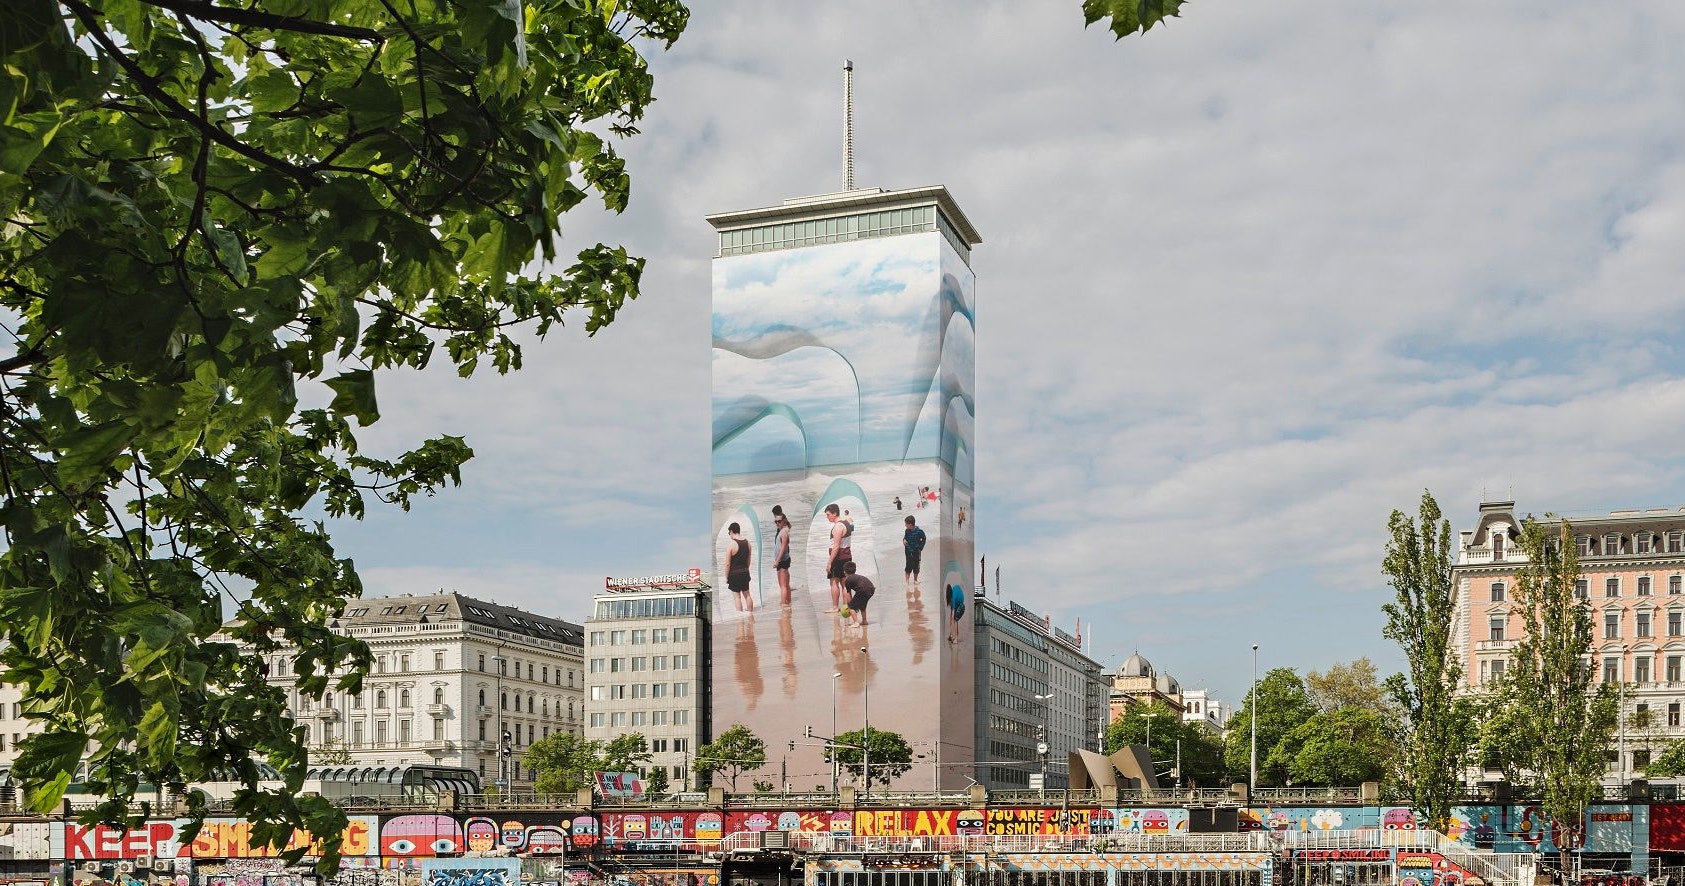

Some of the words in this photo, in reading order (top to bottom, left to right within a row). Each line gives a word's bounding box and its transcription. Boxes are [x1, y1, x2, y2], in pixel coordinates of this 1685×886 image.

[607, 577, 638, 586] WIENER
[987, 810, 1013, 821] YOU
[1019, 810, 1045, 821] ARE
[1051, 810, 1090, 822] JST
[855, 811, 952, 836] RELAX
[987, 822, 1040, 835] COSMIC
[65, 823, 174, 859] KEEP
[1299, 850, 1330, 858] KEEP
